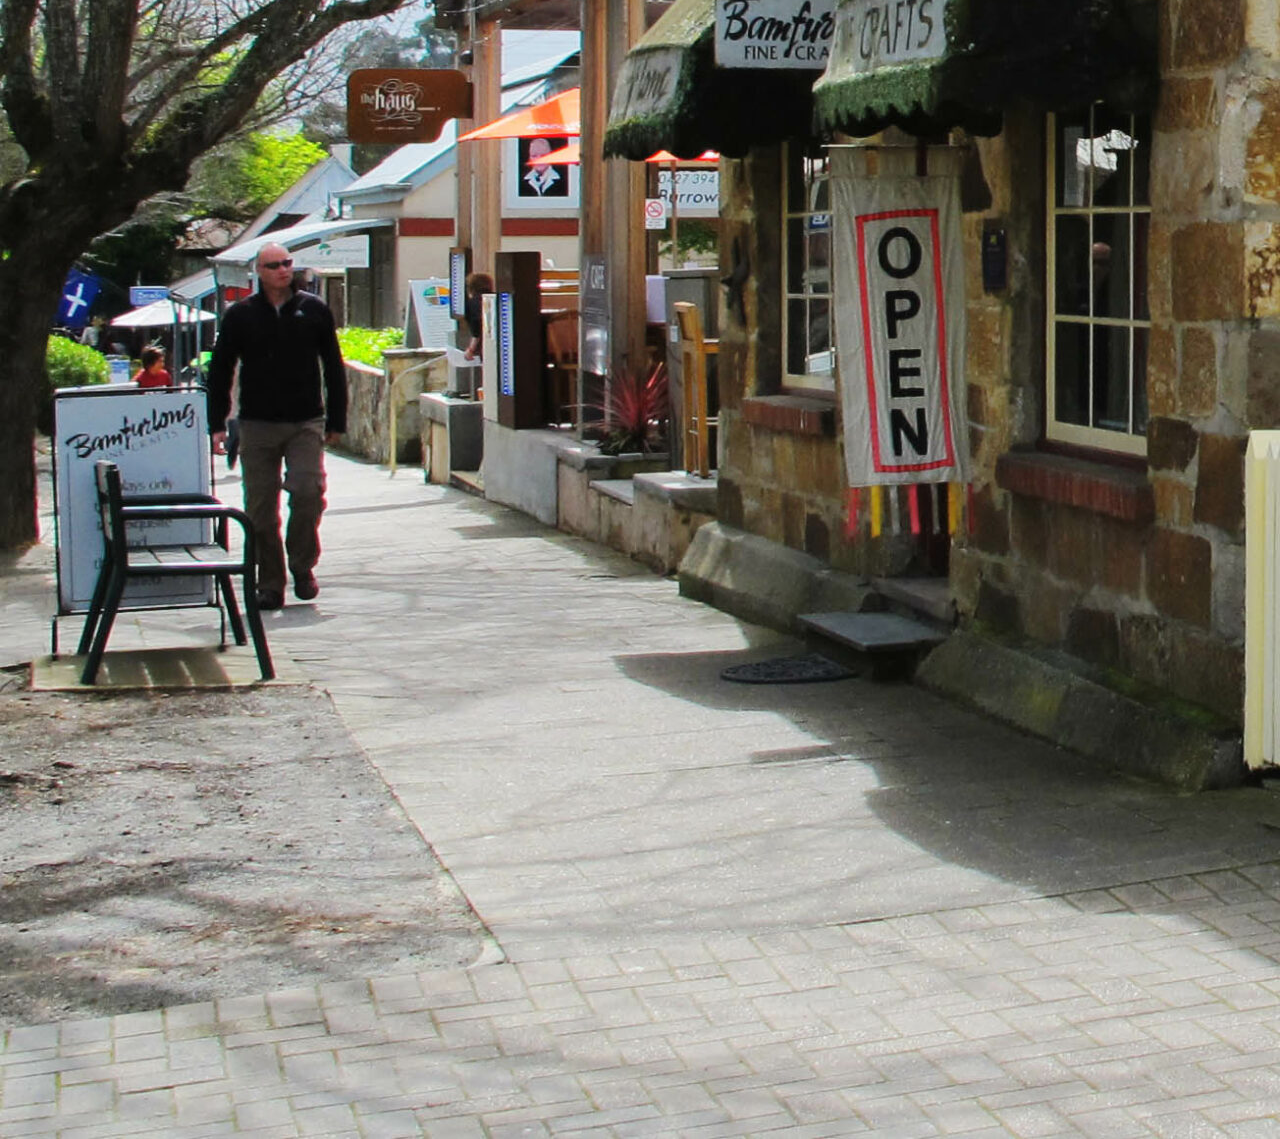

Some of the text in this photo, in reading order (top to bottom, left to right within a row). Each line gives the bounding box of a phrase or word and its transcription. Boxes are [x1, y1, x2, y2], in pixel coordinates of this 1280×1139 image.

[744, 46, 778, 60] FINE
[374, 88, 416, 111] haus
[878, 226, 929, 457] OPEN
[66, 403, 196, 459] Bamfurlong
